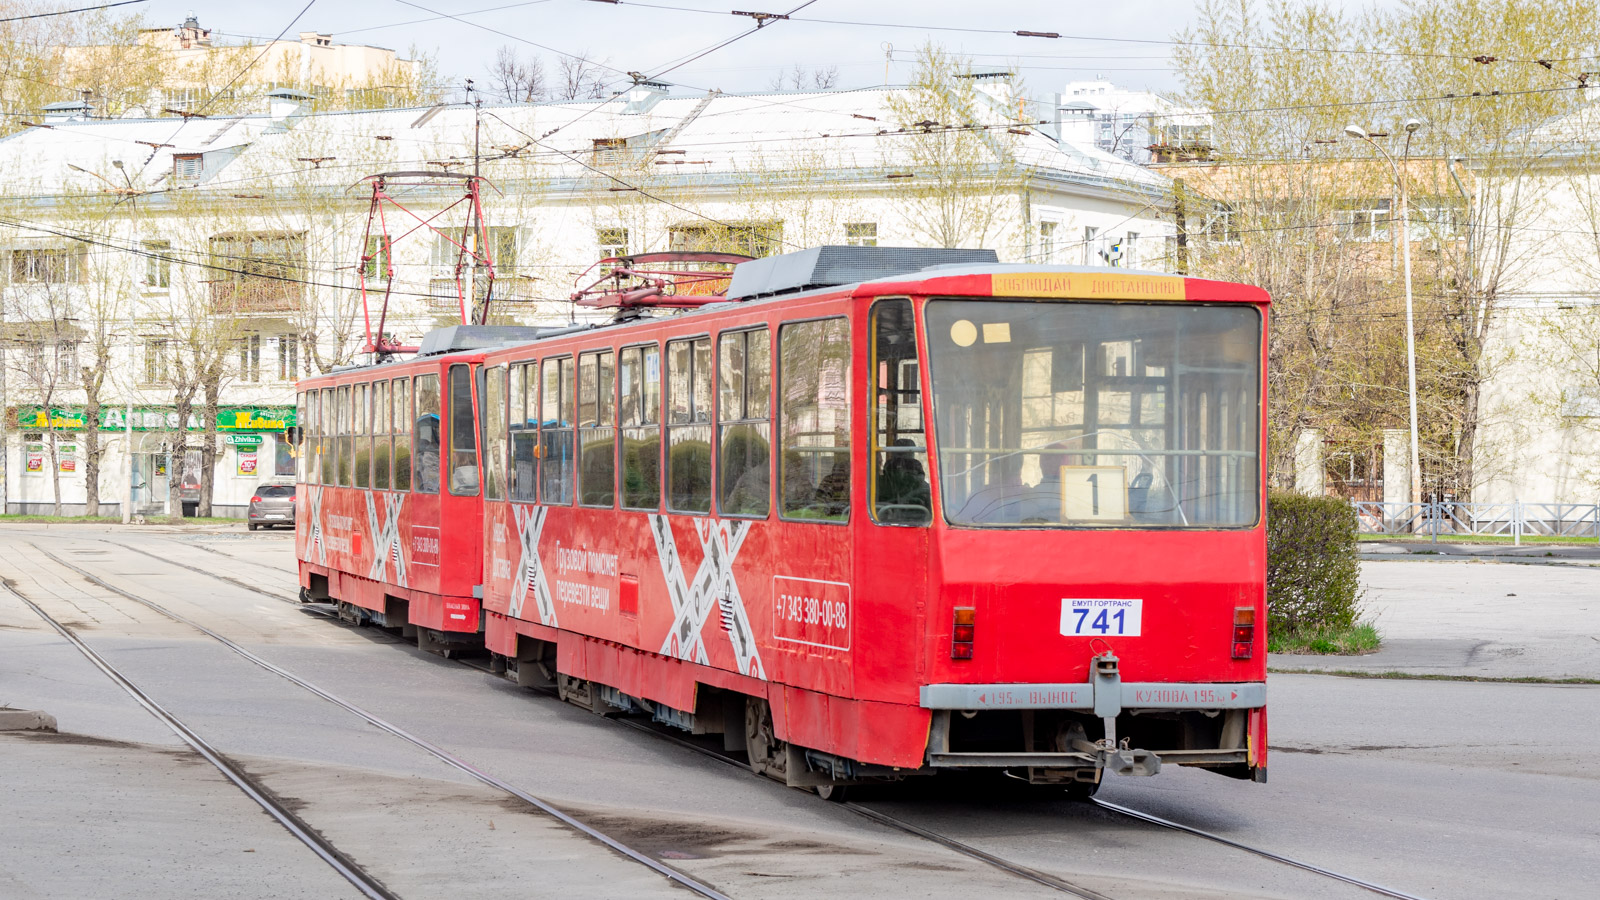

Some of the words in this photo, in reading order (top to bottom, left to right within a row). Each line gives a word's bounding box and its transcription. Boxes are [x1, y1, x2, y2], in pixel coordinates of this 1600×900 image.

[235, 411, 285, 429] Живика
[1086, 473, 1099, 515] 1
[556, 540, 587, 576] Грузовой
[588, 551, 618, 577] поможет
[557, 580, 590, 608] перевезти
[591, 586, 609, 616] вещи
[776, 594, 786, 620] +7
[787, 595, 802, 623] 343
[804, 597, 846, 629] 380-00-88
[1073, 608, 1125, 634] 741
[1029, 691, 1078, 704] ВЫНОС
[1136, 690, 1189, 703] КУЗОВА
